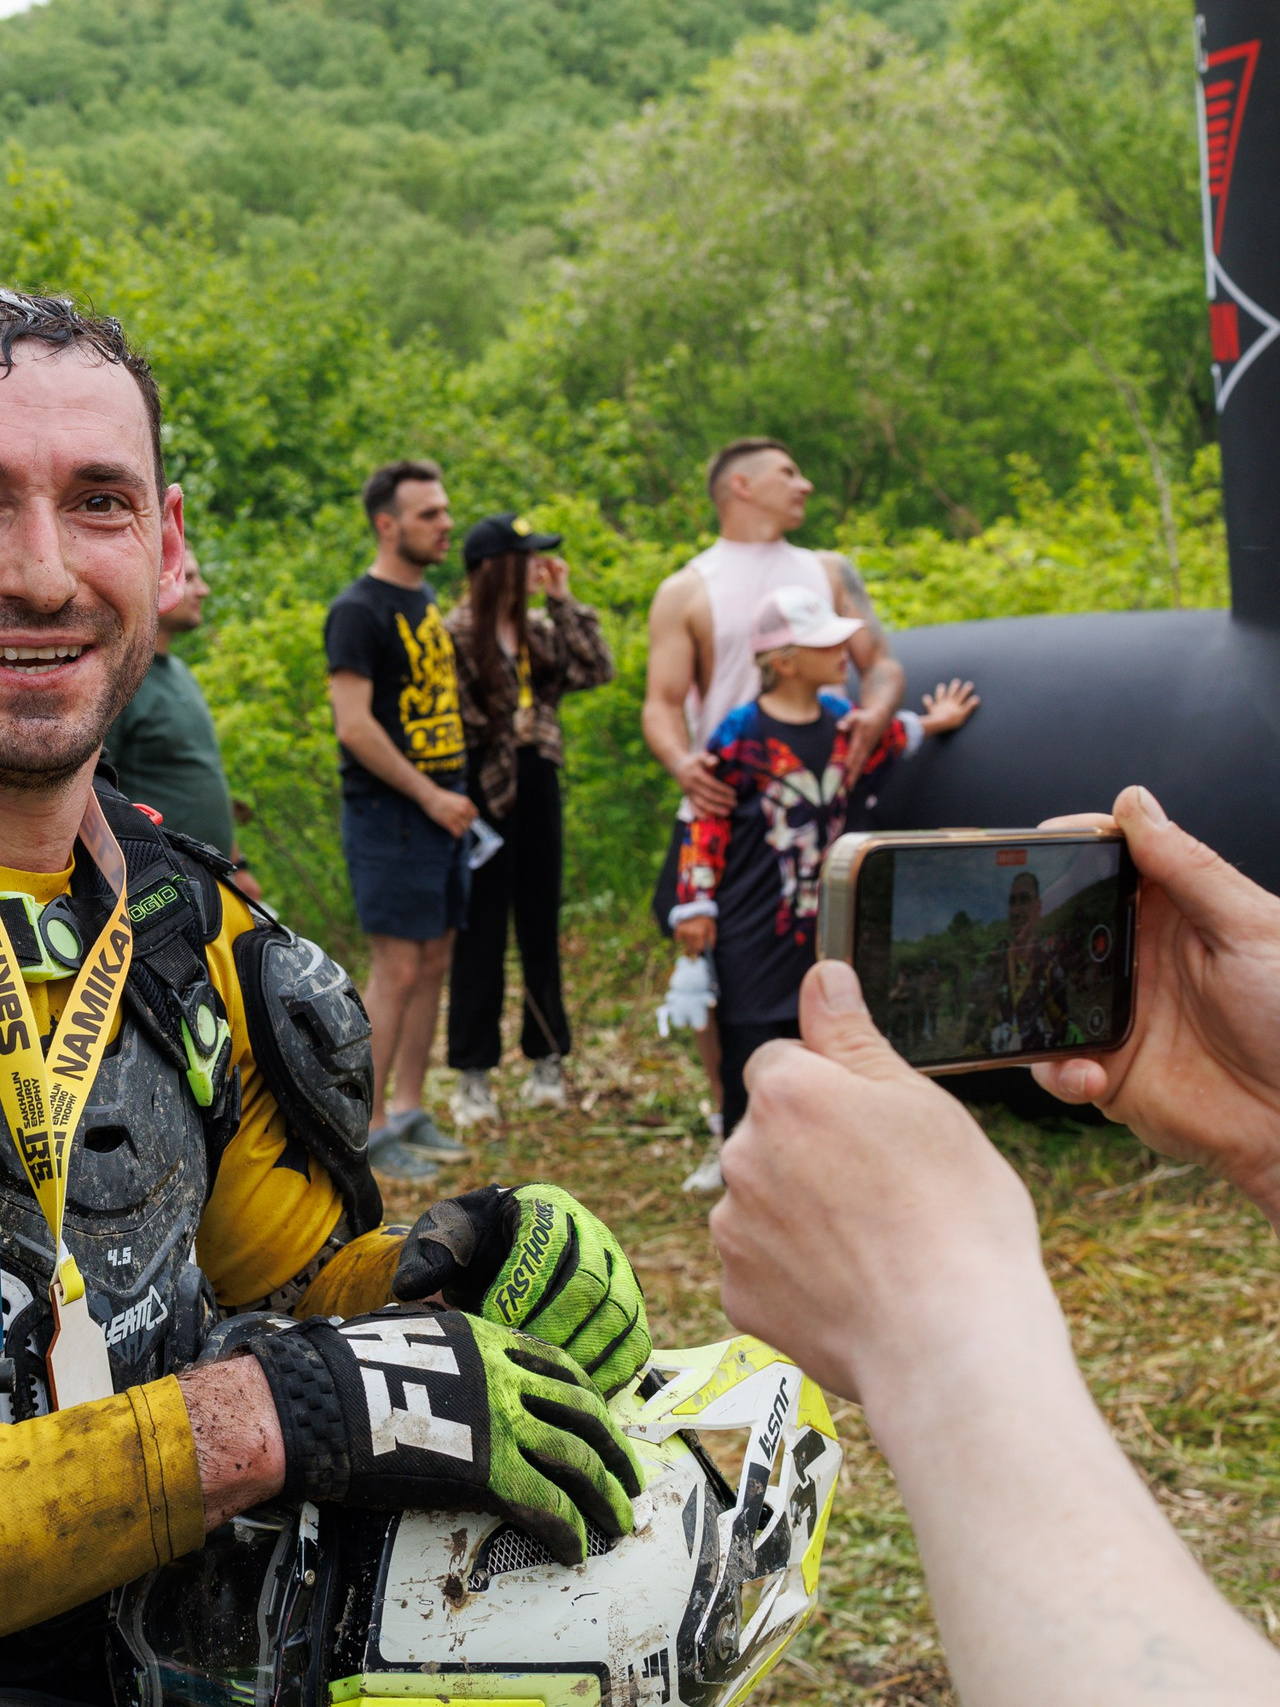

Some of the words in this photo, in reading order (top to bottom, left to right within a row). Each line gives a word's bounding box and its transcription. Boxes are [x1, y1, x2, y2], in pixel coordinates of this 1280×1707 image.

[128, 885, 179, 922] OGIO
[11, 1071, 30, 1129] SAKHALIN
[23, 1078, 37, 1127] ENDURO
[31, 1078, 45, 1126] TROPHY
[59, 1093, 77, 1126] TROPHY
[107, 1246, 132, 1267] 4.5
[494, 1199, 554, 1325] FASTHOUSE
